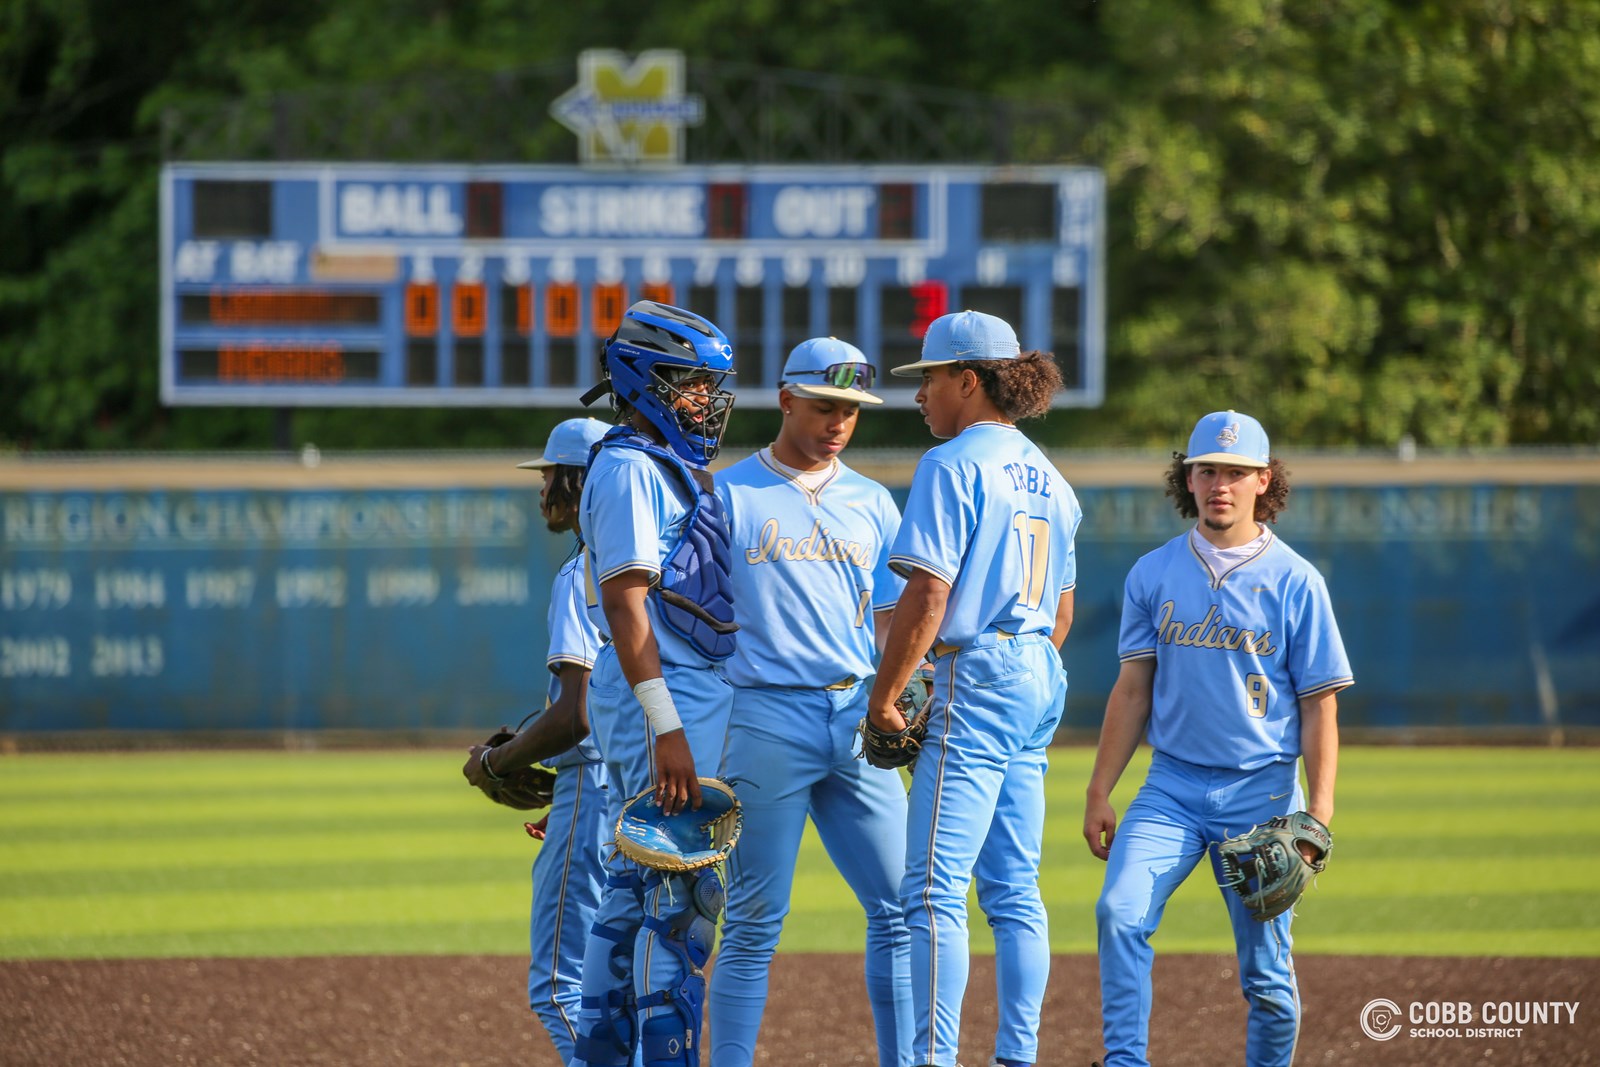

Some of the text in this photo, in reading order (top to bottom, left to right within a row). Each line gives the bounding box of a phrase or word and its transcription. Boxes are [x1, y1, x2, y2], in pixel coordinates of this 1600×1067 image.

[340, 184, 462, 236] BALL
[540, 184, 706, 237] STRIKE
[773, 185, 876, 238] OUT
[176, 240, 299, 284] AT BAT
[410, 251, 436, 284] 1
[457, 251, 485, 284] 2
[692, 251, 720, 286] 7
[823, 251, 867, 287] 10
[405, 281, 440, 338] 0
[452, 281, 488, 338] 0
[545, 281, 581, 338] 0
[592, 281, 628, 338] 0
[2, 498, 527, 541] REGION CHAMPIONSHIPS
[745, 517, 873, 571] Indians
[0, 568, 73, 610] 1979
[1157, 599, 1277, 657] Indians
[1244, 671, 1270, 719] 8
